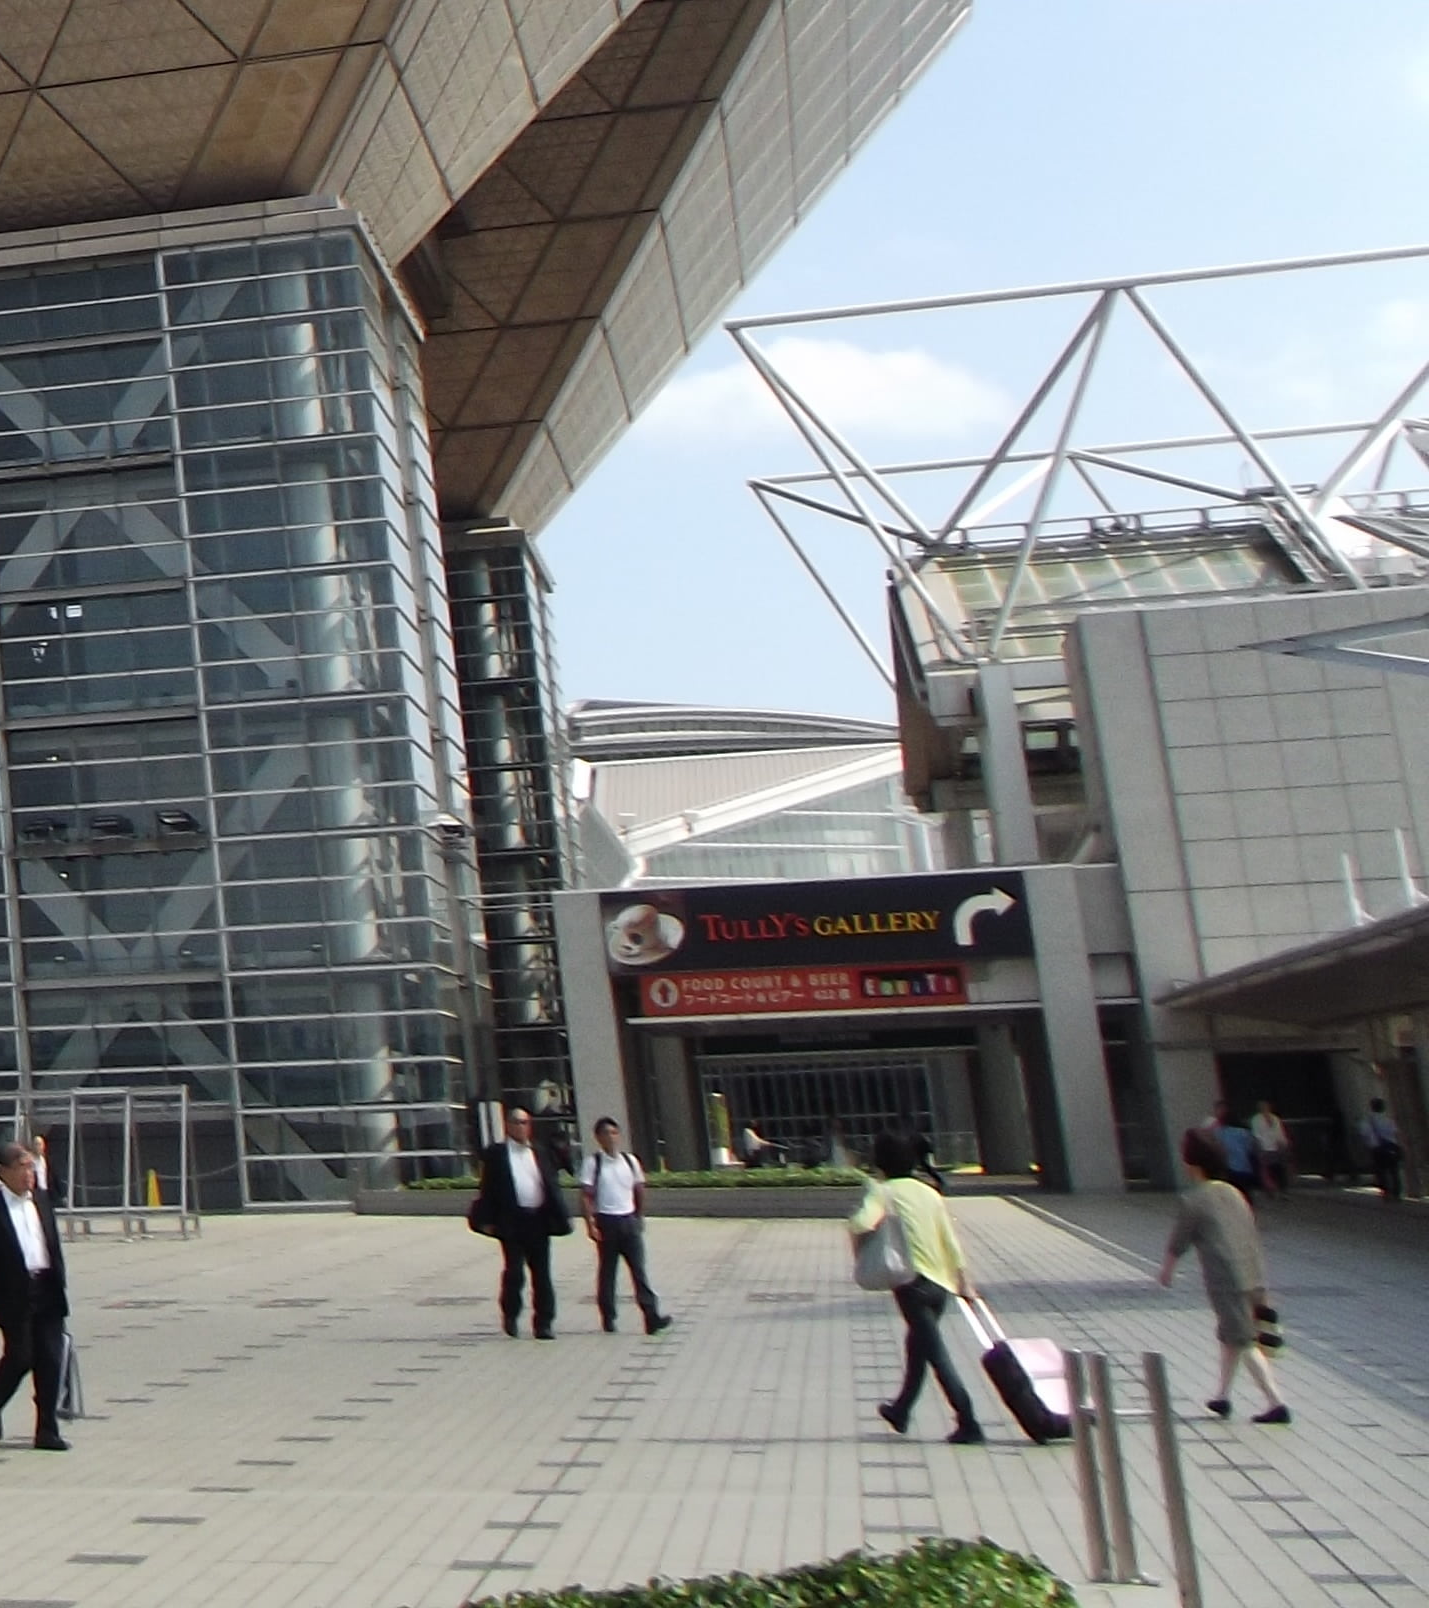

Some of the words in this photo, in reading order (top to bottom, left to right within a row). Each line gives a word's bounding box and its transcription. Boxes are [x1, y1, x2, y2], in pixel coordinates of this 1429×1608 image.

[812, 910, 941, 936] GALLERY
[682, 978, 725, 991] FOOD
[730, 975, 782, 990] COURT
[808, 973, 850, 987] BEER
